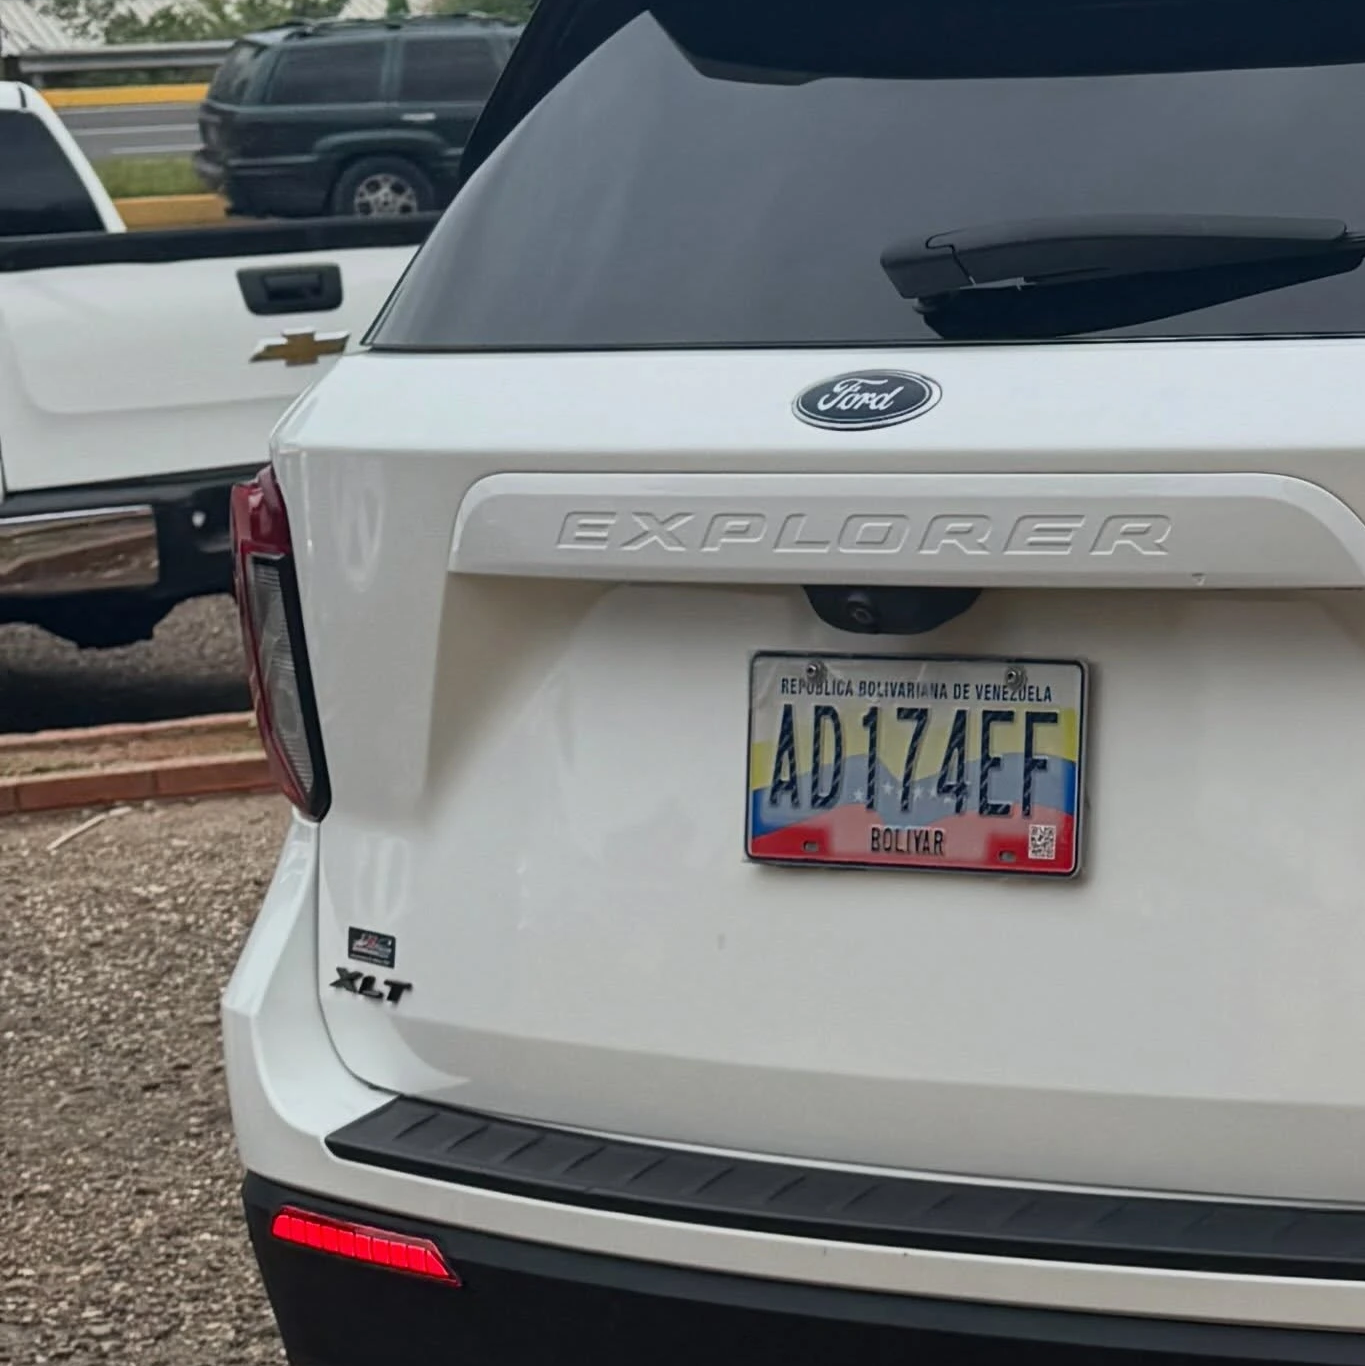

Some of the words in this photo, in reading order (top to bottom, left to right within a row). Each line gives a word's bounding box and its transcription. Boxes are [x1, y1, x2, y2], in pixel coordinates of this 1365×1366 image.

[816, 378, 904, 411] Ford
[556, 510, 1173, 558] EXPLORER
[858, 680, 948, 700] BOLIVARIANA
[953, 683, 970, 700] DE
[975, 683, 1052, 702] VENEZUELA
[768, 704, 1058, 817] AD174EF
[870, 827, 945, 855] BOLIVAR
[329, 967, 413, 1003] XLT
